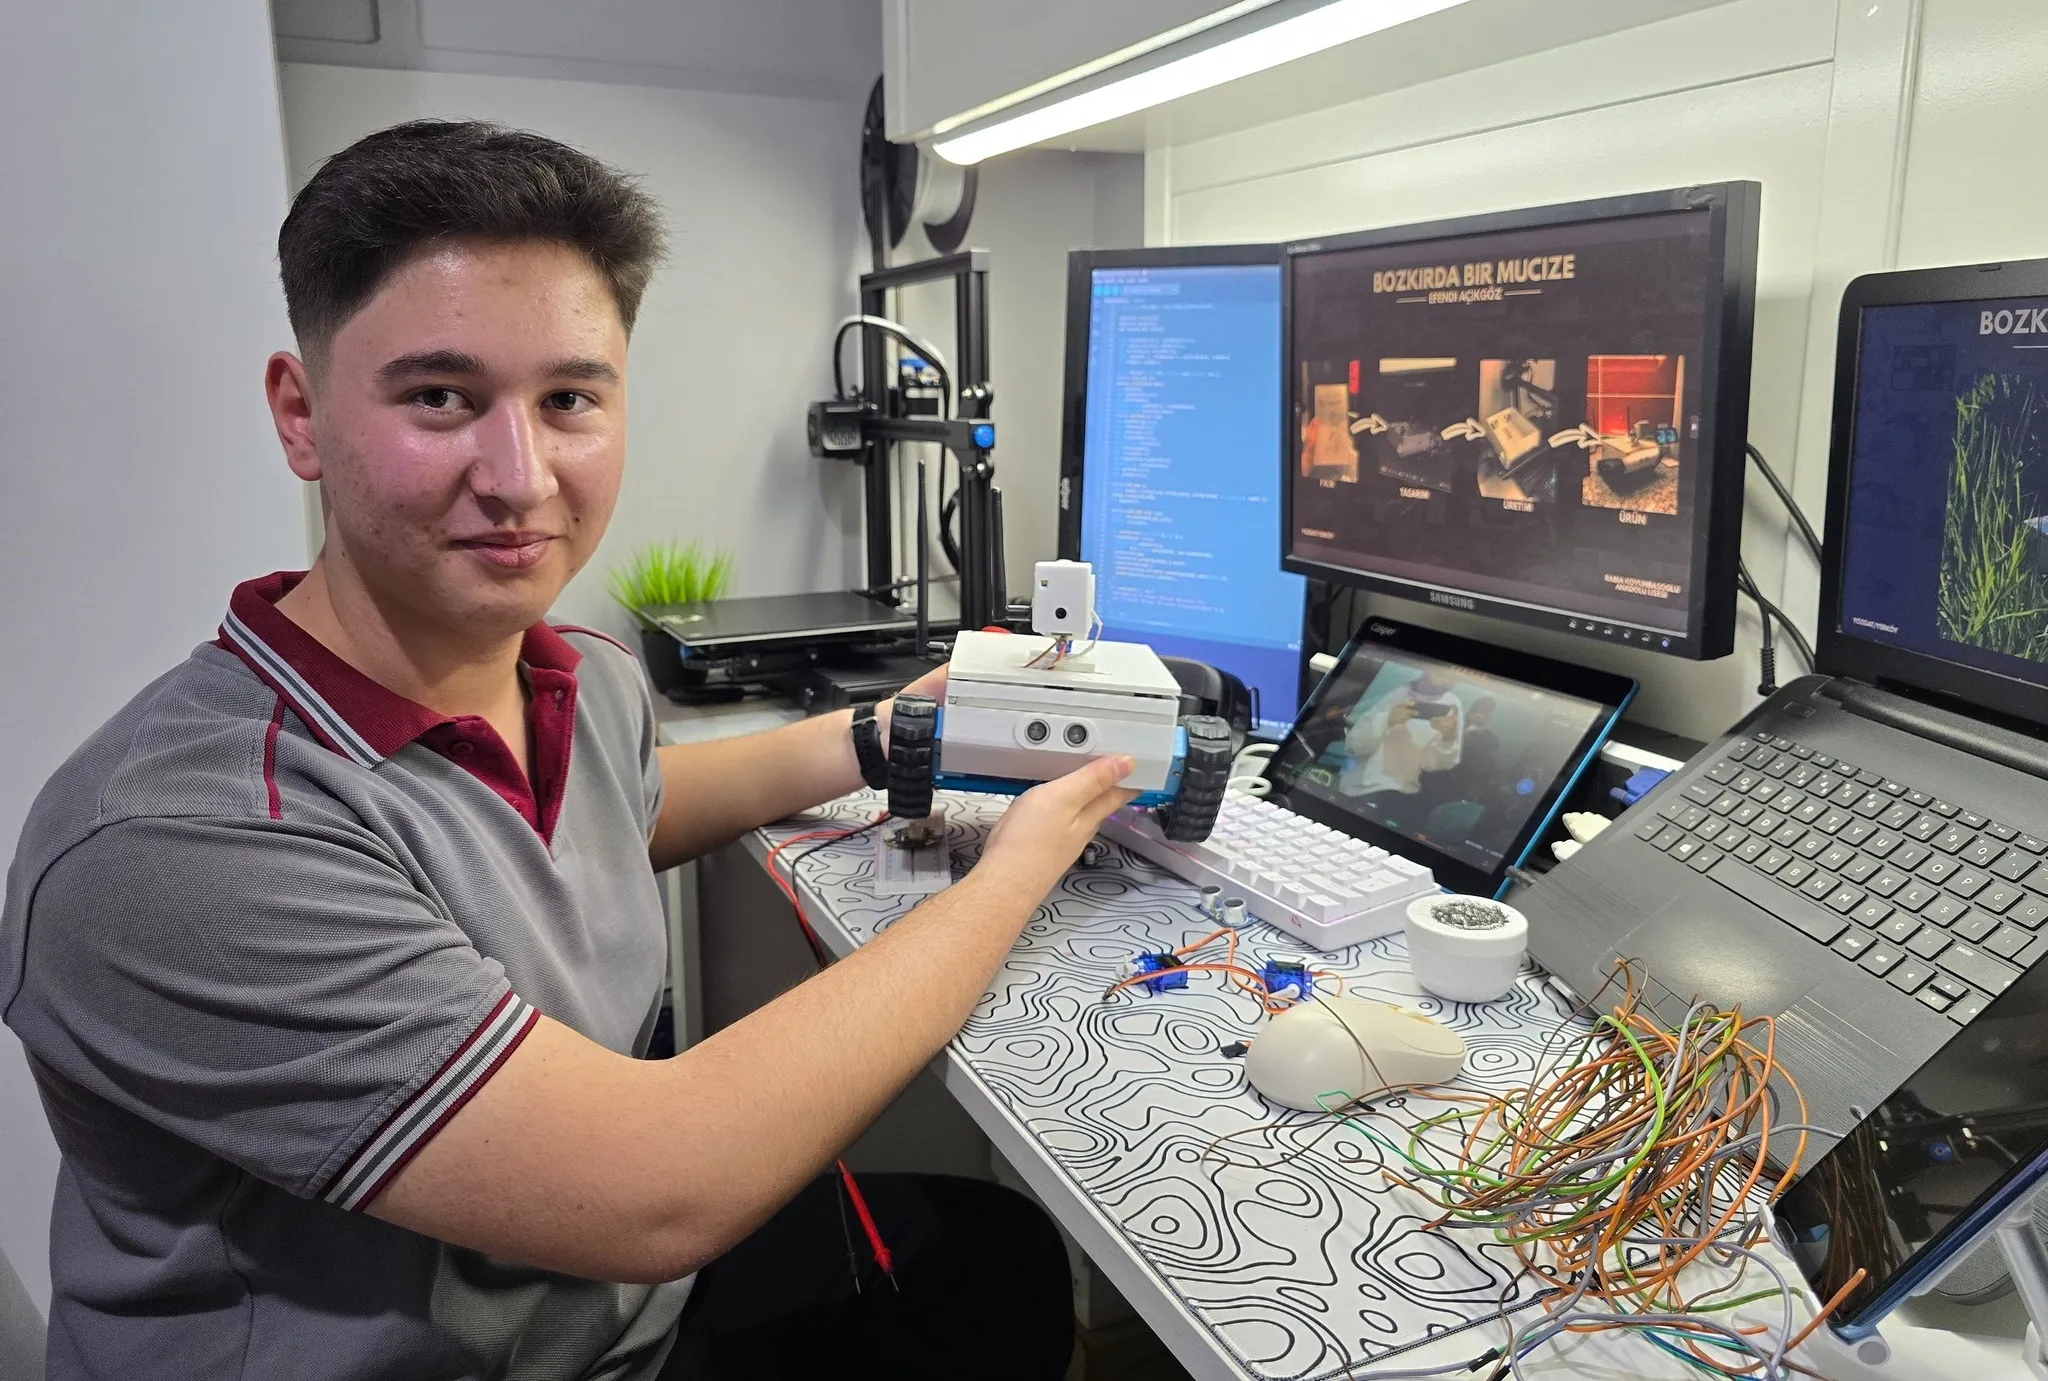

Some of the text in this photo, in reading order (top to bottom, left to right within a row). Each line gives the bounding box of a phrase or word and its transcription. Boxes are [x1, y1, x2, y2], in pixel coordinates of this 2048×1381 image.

[1373, 265, 1460, 294] BOZKIRDA
[1979, 308, 2048, 335] BOZK
[1618, 508, 1648, 526] ÜRÜN
[1429, 590, 1475, 610] SAMSUNG
